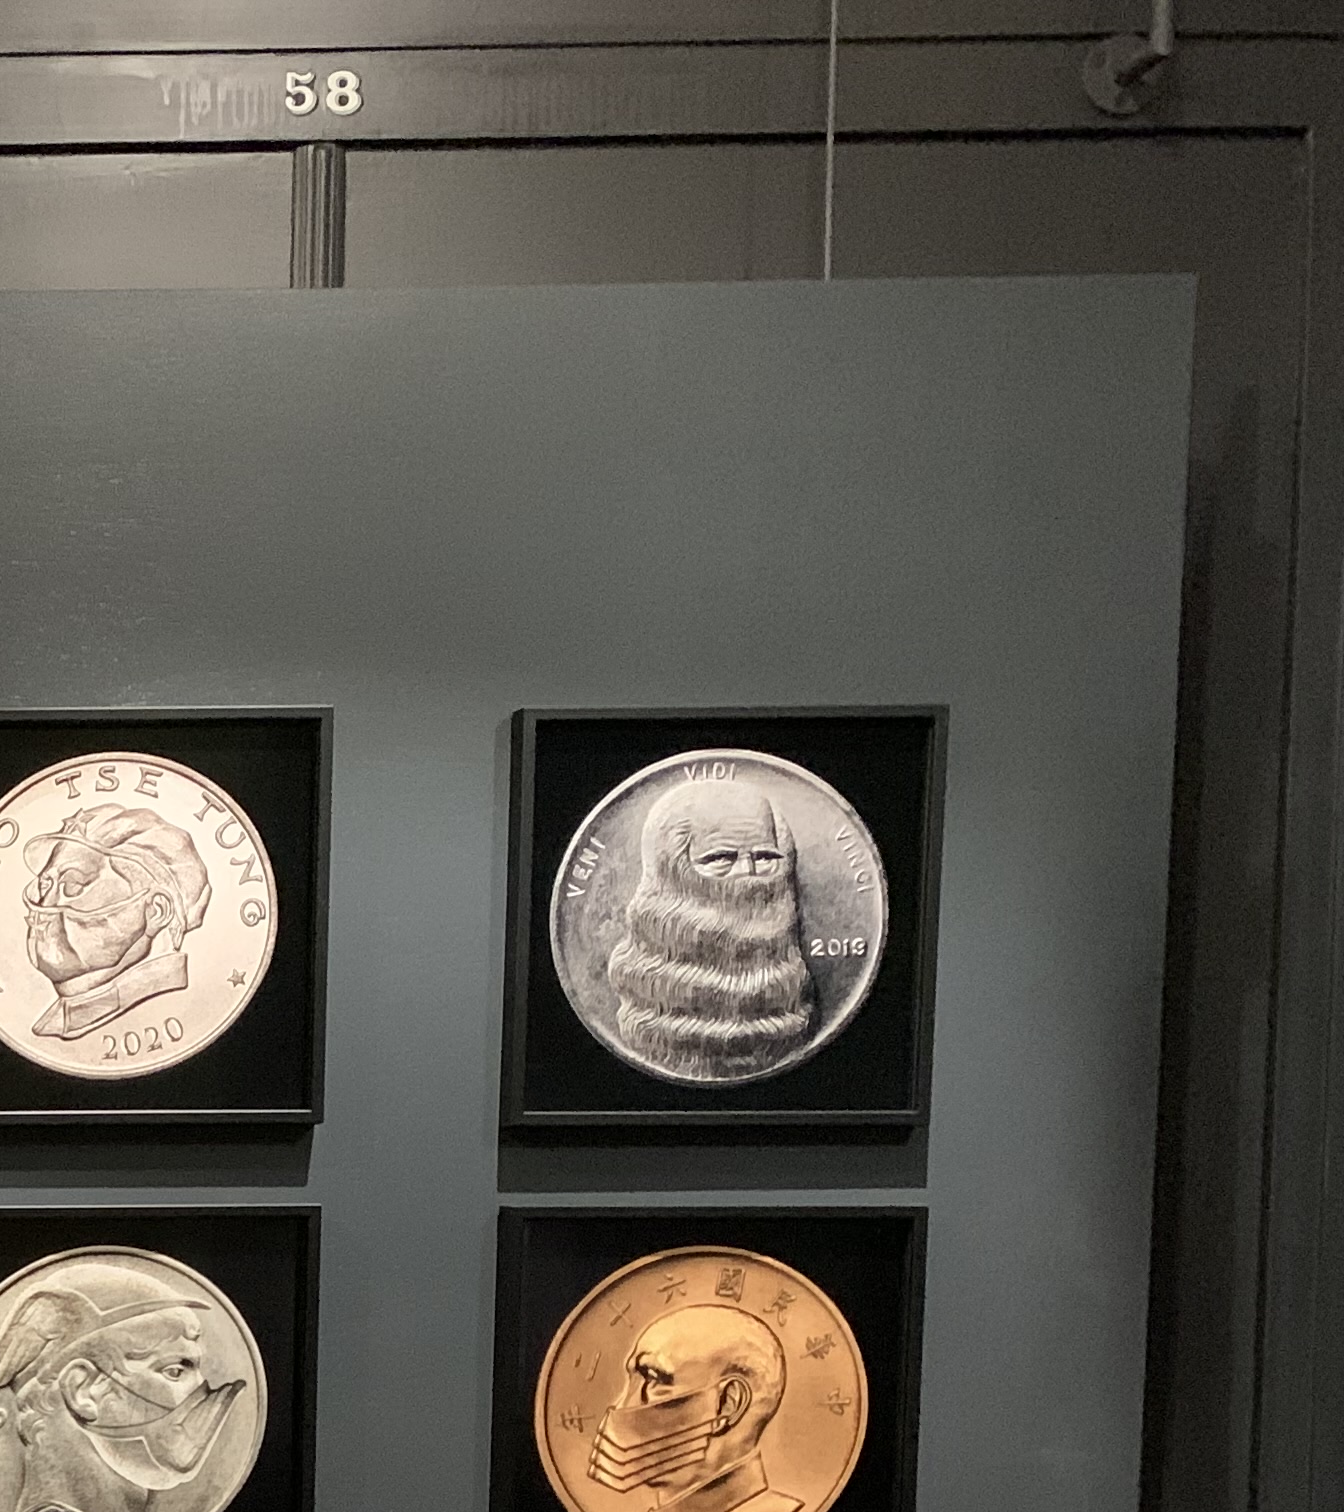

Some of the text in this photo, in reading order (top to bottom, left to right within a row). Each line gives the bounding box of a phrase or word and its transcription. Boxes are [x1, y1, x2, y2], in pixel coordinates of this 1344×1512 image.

[285, 70, 363, 115] 58
[55, 766, 164, 799] TSE
[193, 791, 267, 928] TUNG
[566, 836, 606, 898] VENI
[683, 762, 736, 781] VIDI
[101, 1016, 184, 1061] 2020
